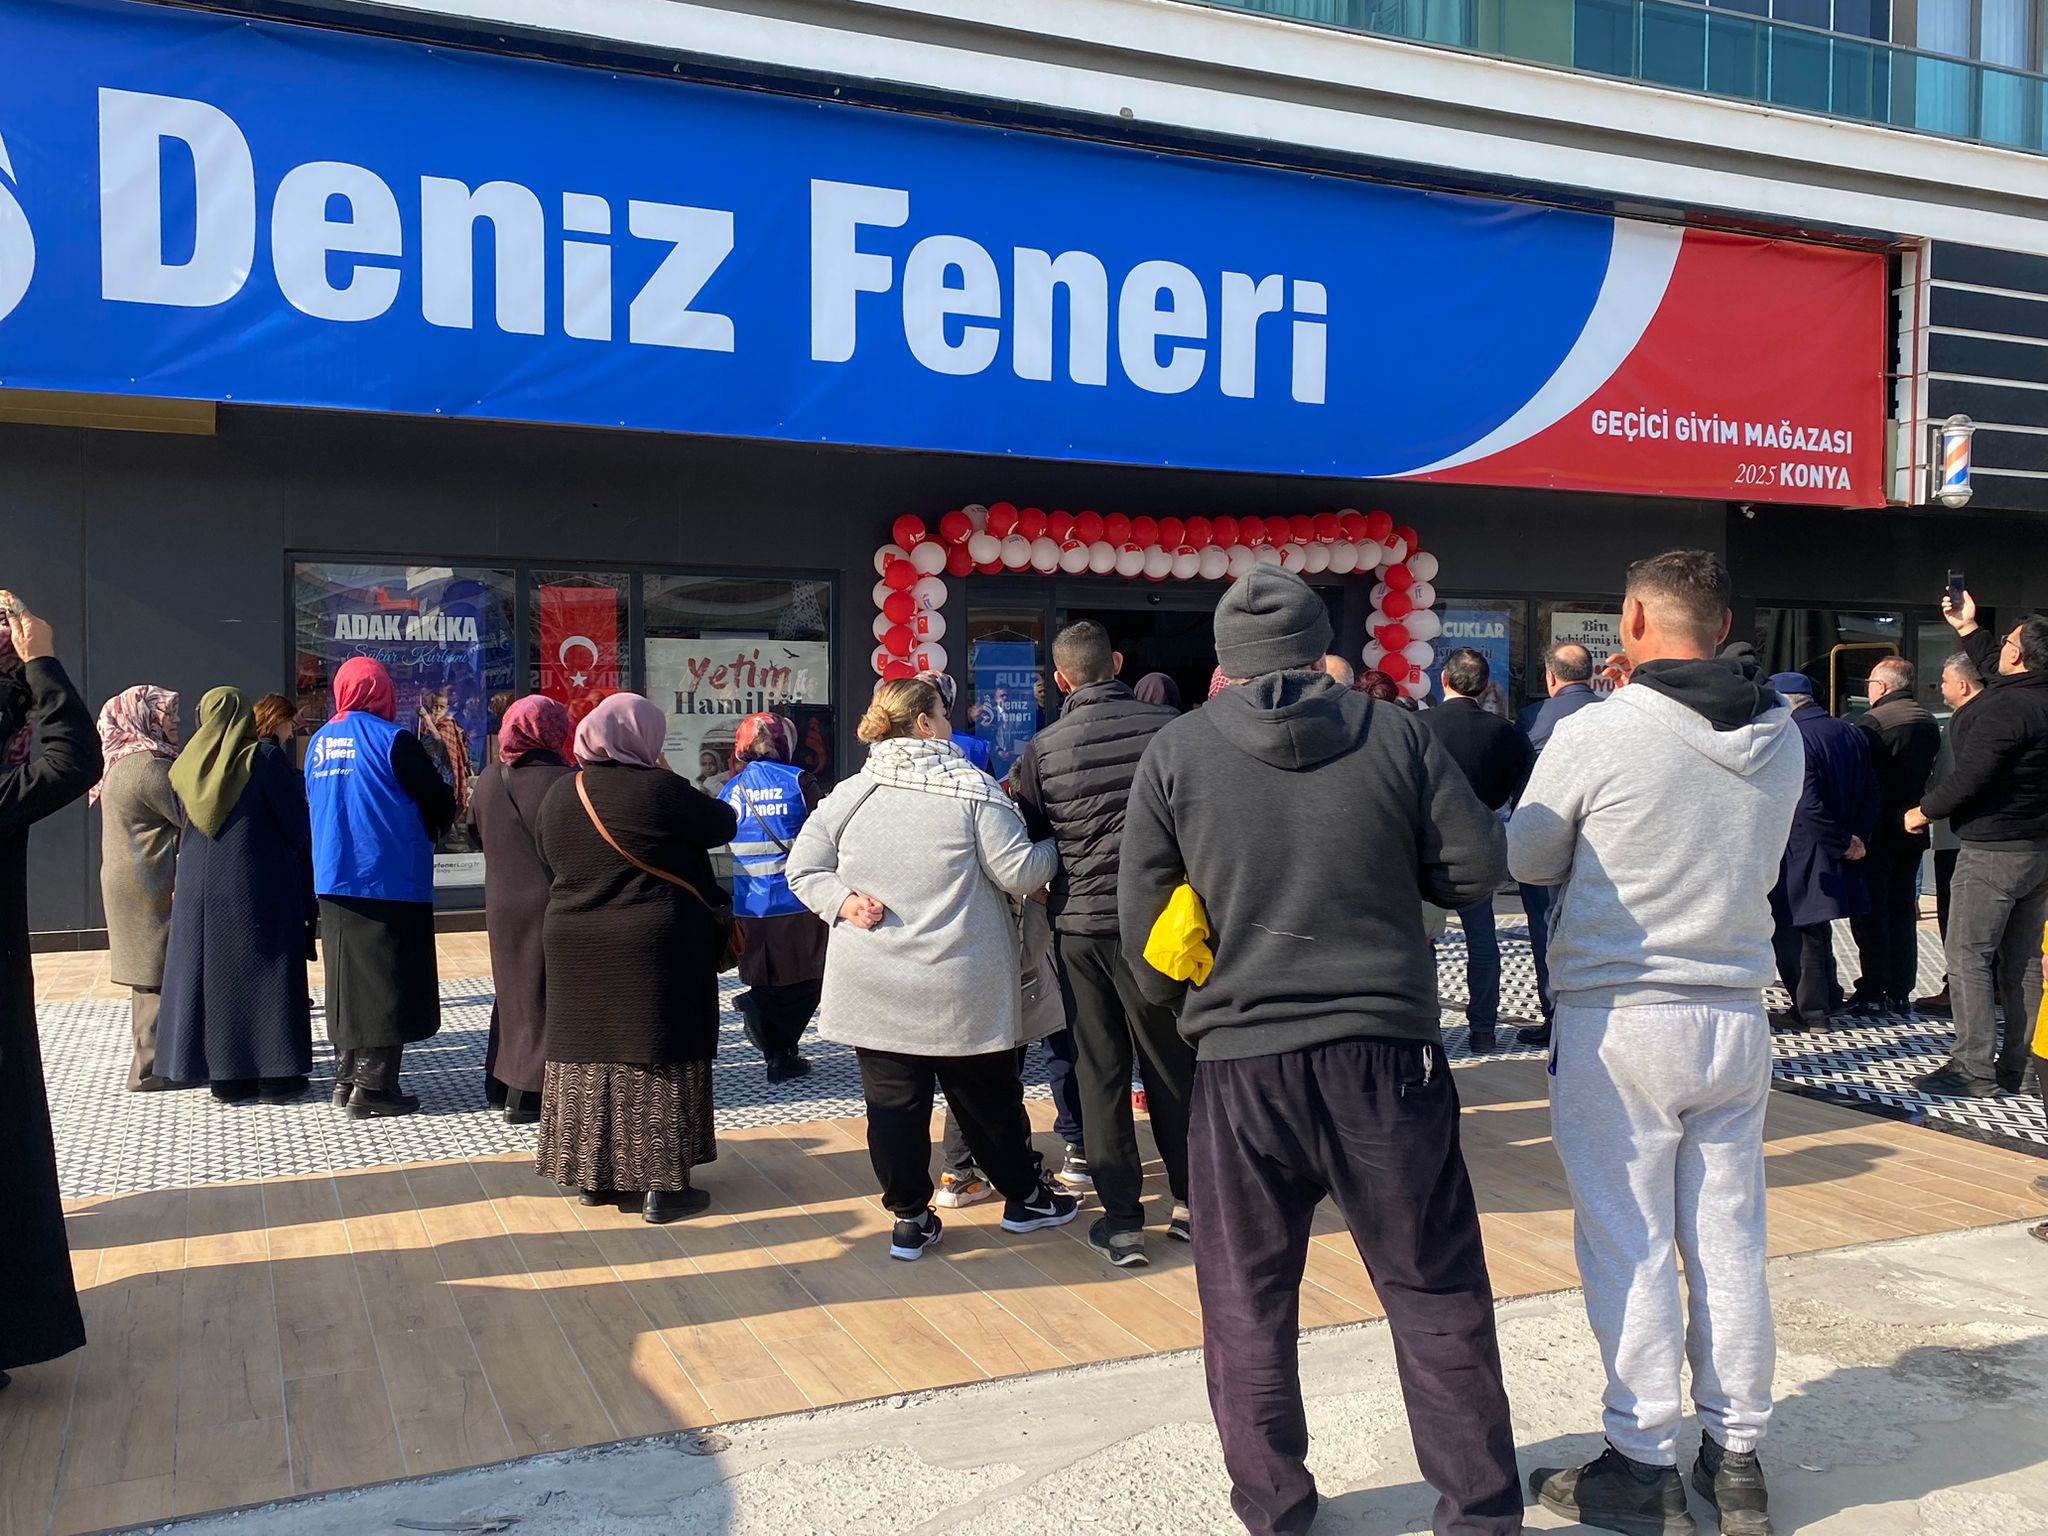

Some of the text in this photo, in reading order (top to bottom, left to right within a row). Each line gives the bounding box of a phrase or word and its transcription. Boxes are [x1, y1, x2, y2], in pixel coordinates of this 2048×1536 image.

[98, 86, 1327, 405] Deniz Feneri
[1591, 406, 1853, 454] GEÇİCİ GİYİM MAĞAZASI
[1734, 462, 1851, 490] 2025 KONYA
[334, 613, 402, 641] ADAK
[1440, 621, 1505, 639] CUKLAR
[1582, 619, 1609, 632] Bin
[688, 648, 792, 693] Yetim
